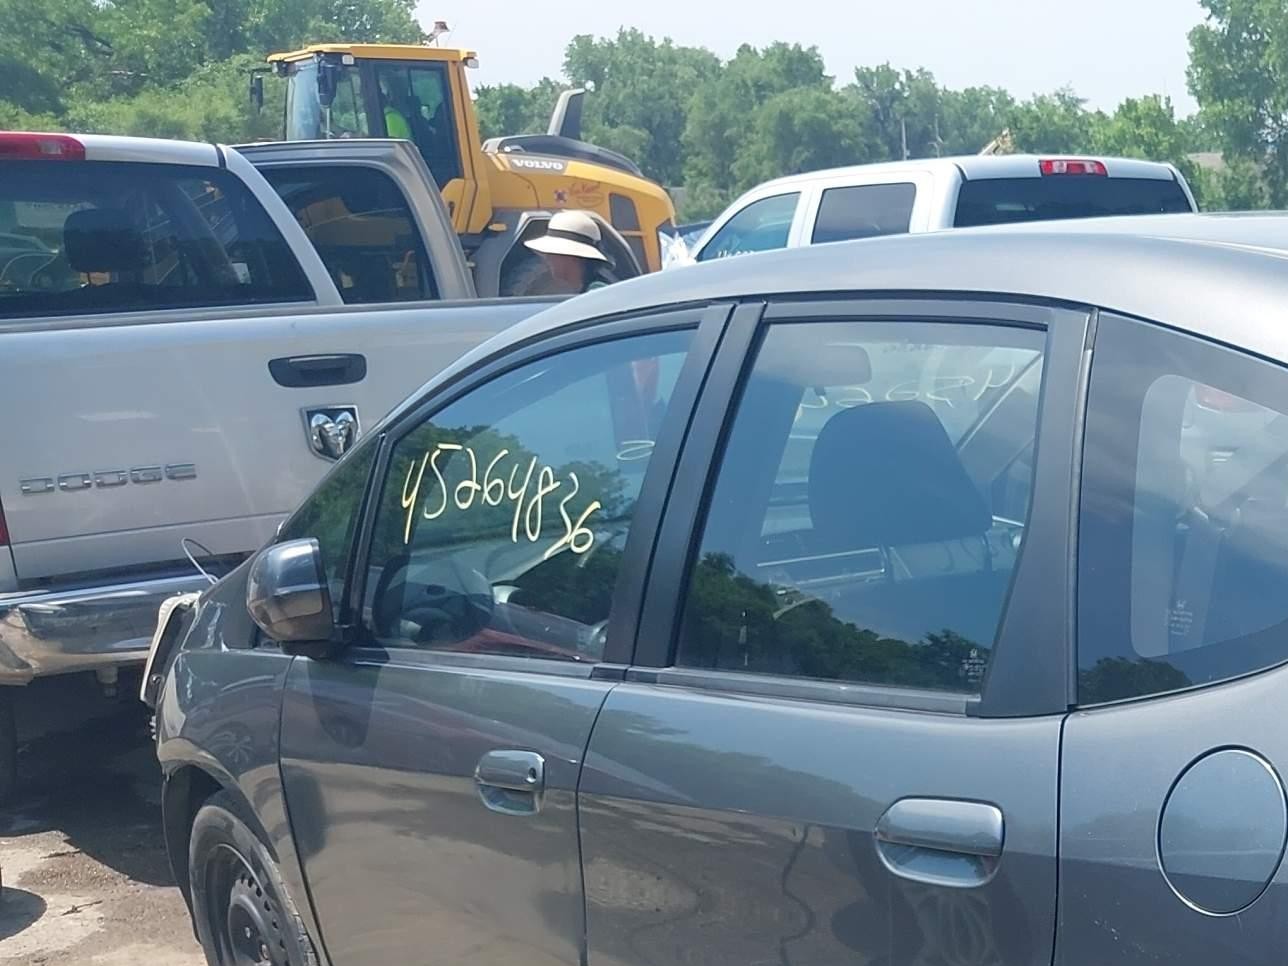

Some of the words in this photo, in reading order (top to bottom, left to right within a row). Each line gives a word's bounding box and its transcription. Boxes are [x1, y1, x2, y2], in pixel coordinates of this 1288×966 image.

[512, 159, 564, 171] VOLVO
[18, 463, 198, 495] DODGE
[401, 442, 602, 561] 45264836
